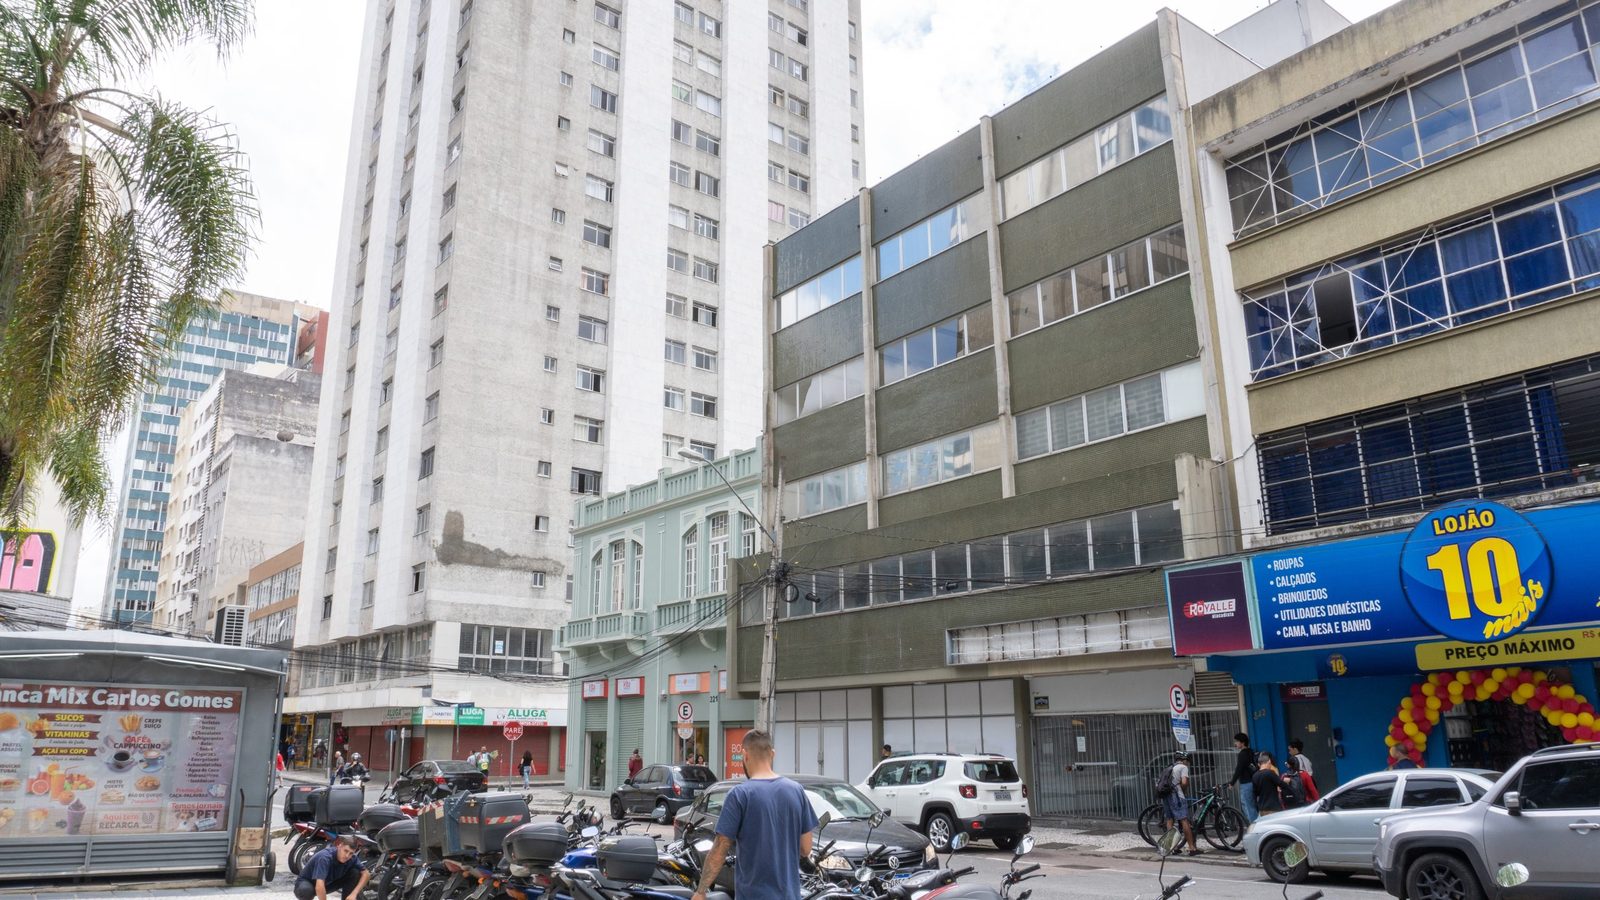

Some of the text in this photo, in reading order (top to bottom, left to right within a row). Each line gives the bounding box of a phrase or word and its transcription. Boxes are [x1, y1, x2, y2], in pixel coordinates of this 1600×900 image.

[1432, 508, 1495, 536] LOJÃO
[1273, 556, 1304, 571] ROUPAS
[1275, 572, 1317, 588] CALÇADOS
[1426, 537, 1522, 620] 10
[1278, 588, 1328, 604] BRINQUEDOS
[1190, 600, 1234, 616] ROYALLE
[1280, 600, 1381, 621] UTILIDADES DOMÉSTICAS
[1482, 579, 1544, 639] mais
[1282, 618, 1371, 638] CAMA, MESA E BANHO
[1445, 637, 1575, 660] PREÇO MÁXIMO
[0, 687, 233, 709] nca Mix Carlos Gomes
[1174, 690, 1183, 707] E
[55, 714, 85, 722] SUCOS
[507, 709, 547, 718] ALUGA
[682, 705, 689, 716] E
[45, 730, 90, 738] VITAMINAS
[196, 810, 220, 819] PET
